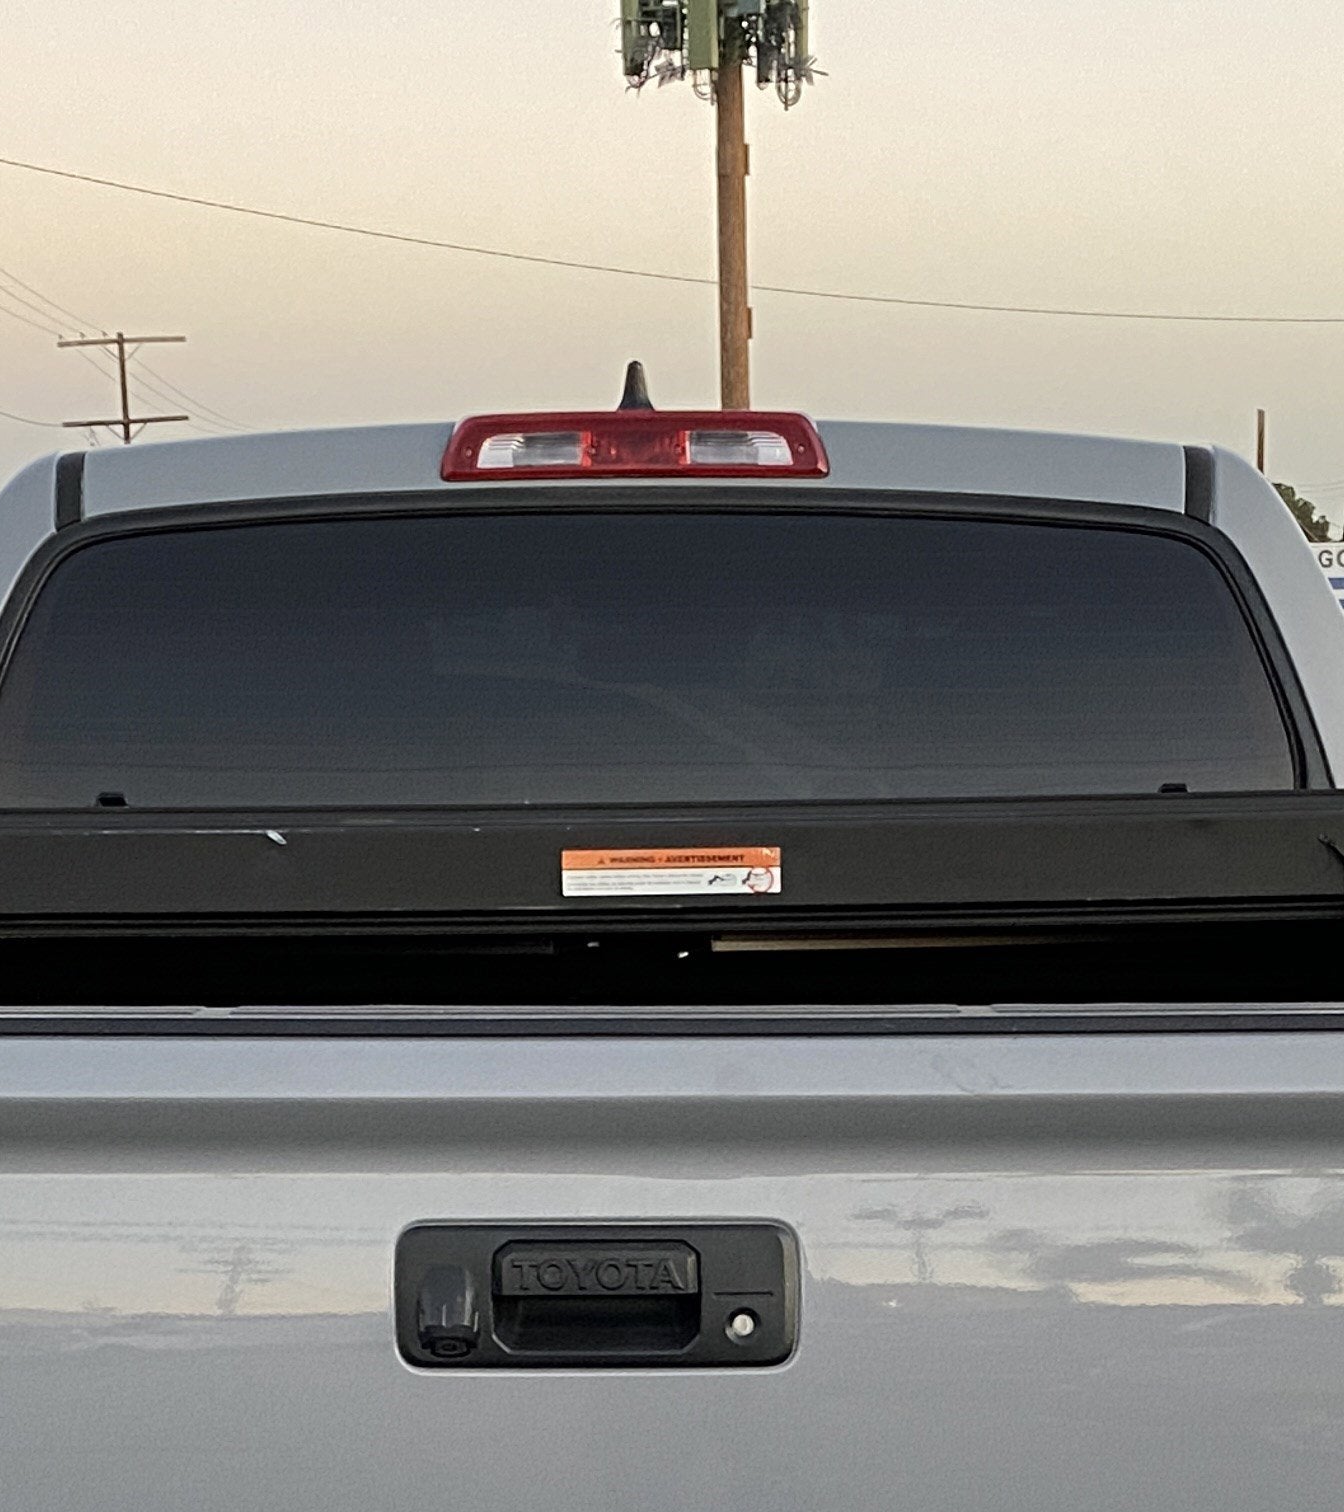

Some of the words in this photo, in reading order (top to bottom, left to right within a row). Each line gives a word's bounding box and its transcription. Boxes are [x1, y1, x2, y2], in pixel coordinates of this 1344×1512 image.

[609, 856, 656, 864] WARNING
[664, 854, 746, 864] AVERTISSEMENT
[511, 1258, 685, 1292] TOYOTA
